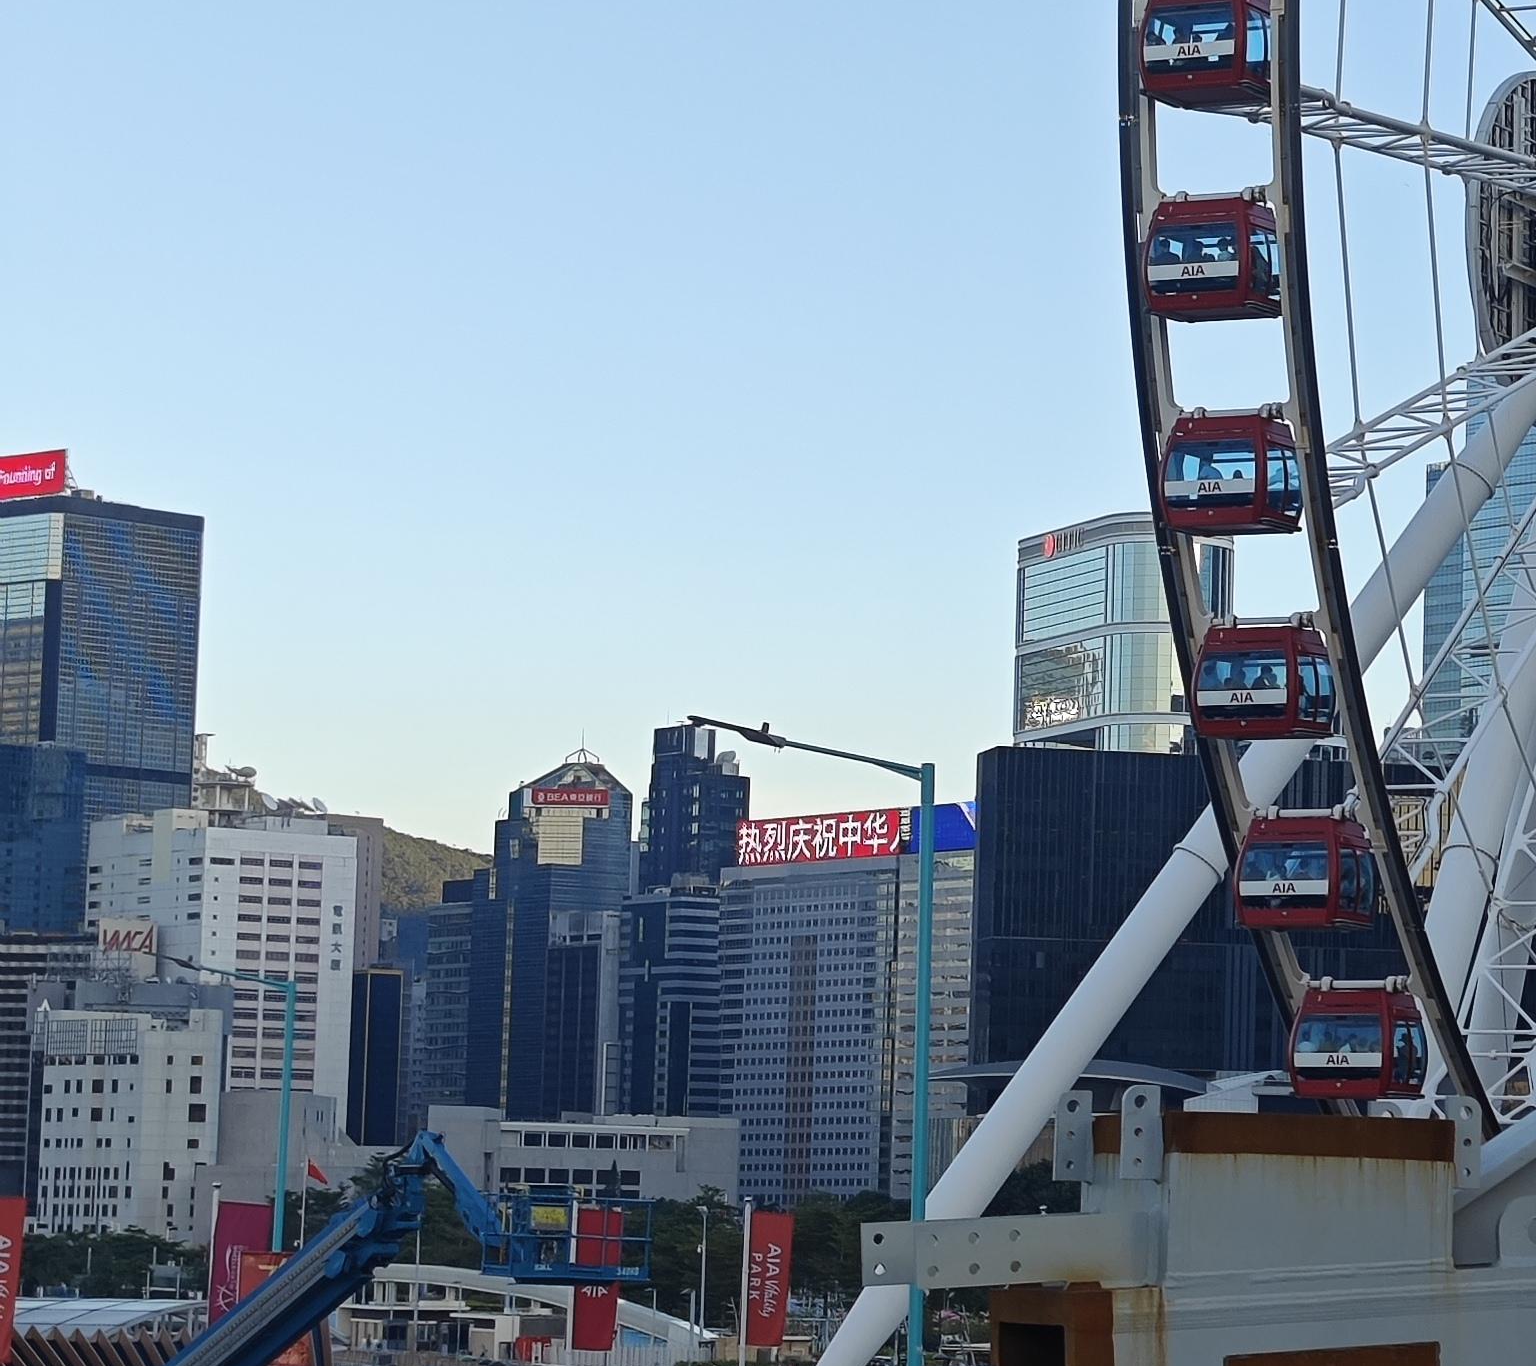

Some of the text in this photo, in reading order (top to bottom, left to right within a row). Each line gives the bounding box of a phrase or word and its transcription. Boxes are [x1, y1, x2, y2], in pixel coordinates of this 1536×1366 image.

[1177, 44, 1201, 57] AIA
[1181, 264, 1205, 277] AIA
[1197, 481, 1222, 494] AIA
[1229, 691, 1254, 703] AIA
[1272, 882, 1296, 894] AIA
[1326, 1054, 1350, 1066] AIA
[749, 1252, 763, 1300] PARK
[759, 1243, 781, 1318] AIA Vitality
